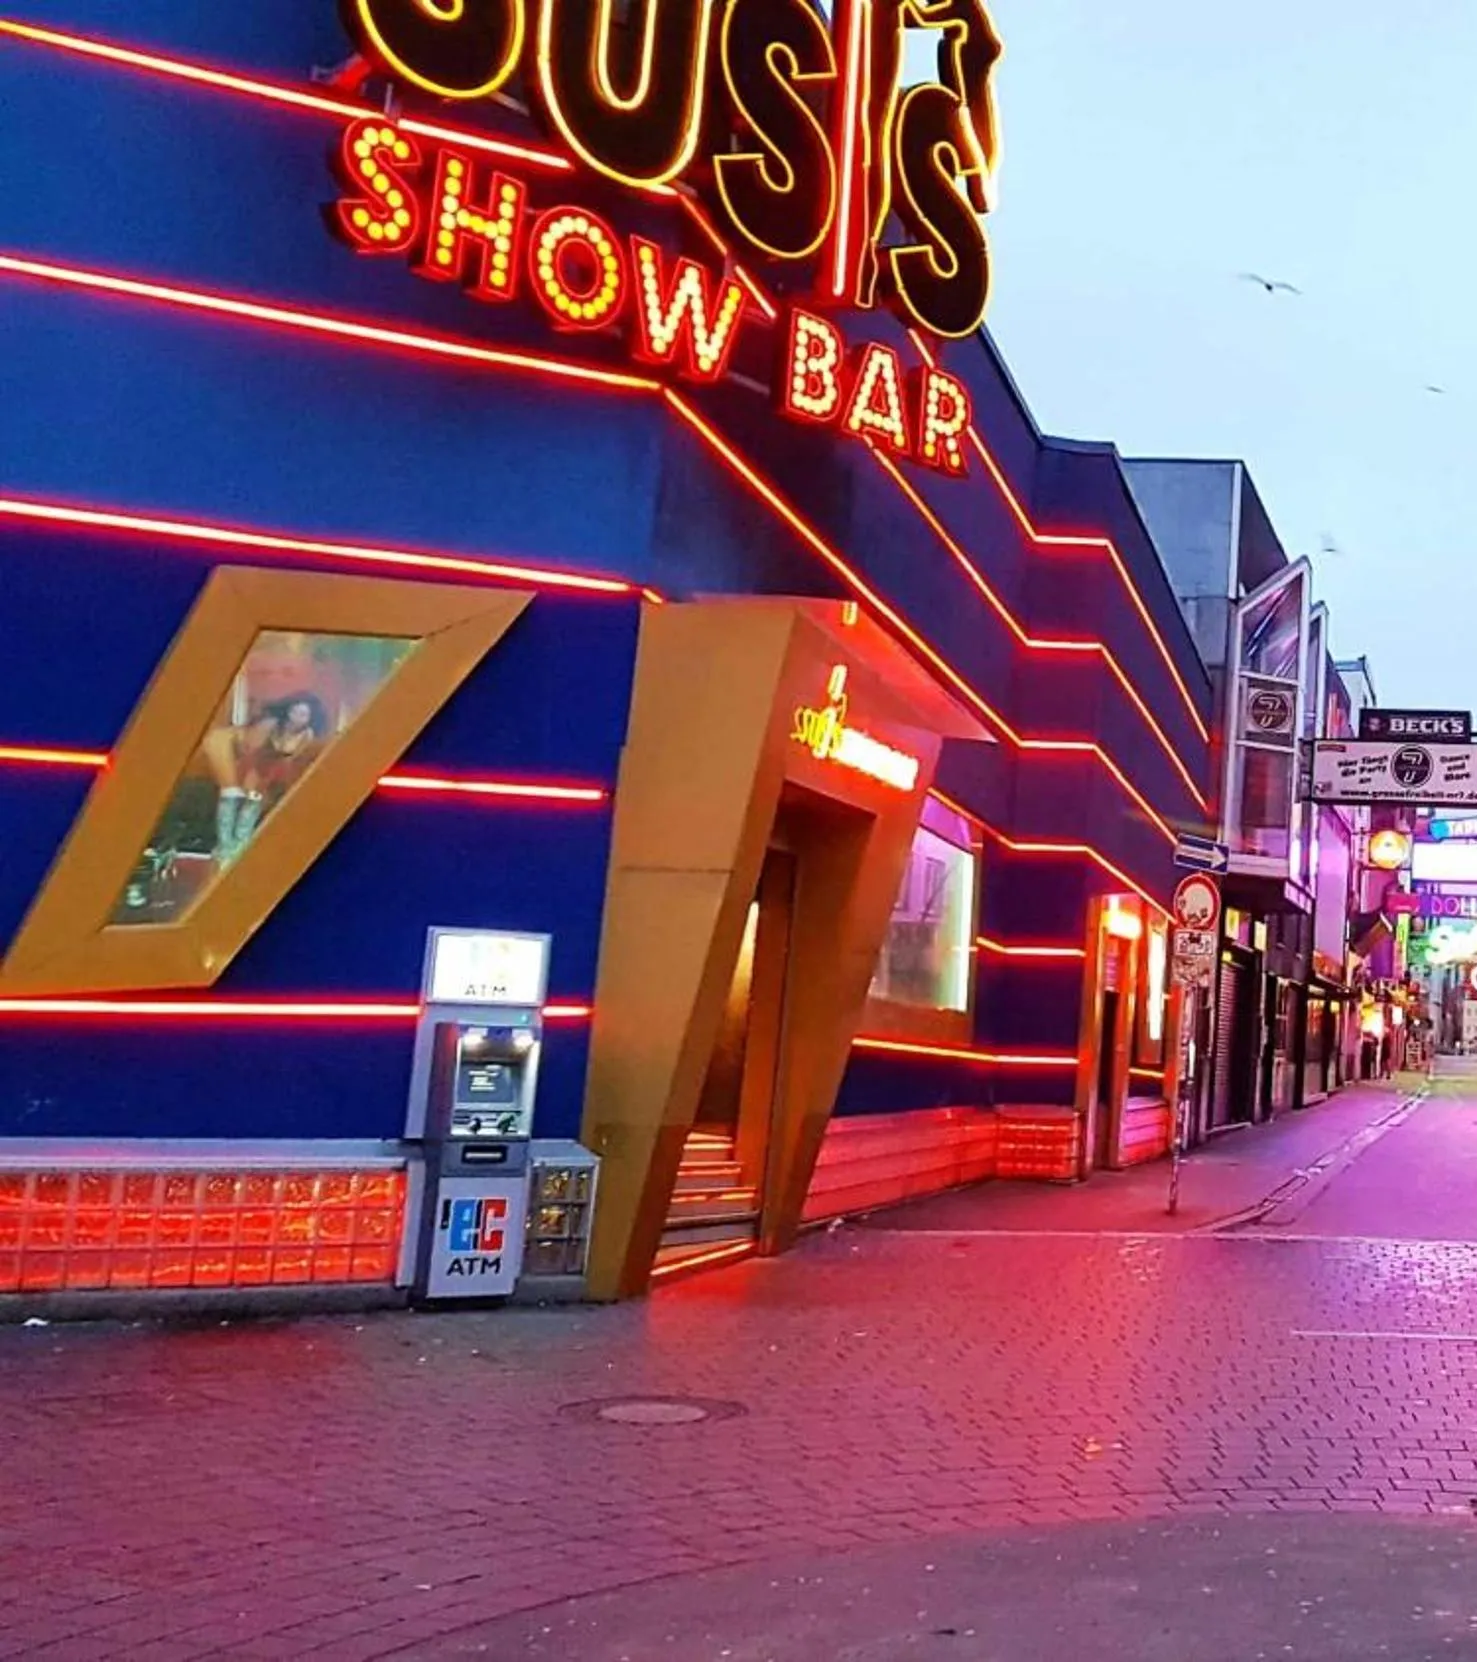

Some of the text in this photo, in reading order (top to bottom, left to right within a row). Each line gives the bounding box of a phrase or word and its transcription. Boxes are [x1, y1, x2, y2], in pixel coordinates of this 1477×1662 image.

[335, 114, 748, 382] SHOW
[786, 308, 971, 477] BAR
[1389, 717, 1464, 734] BECK'S
[463, 983, 508, 998] ATM
[446, 1256, 502, 1277] ATM
